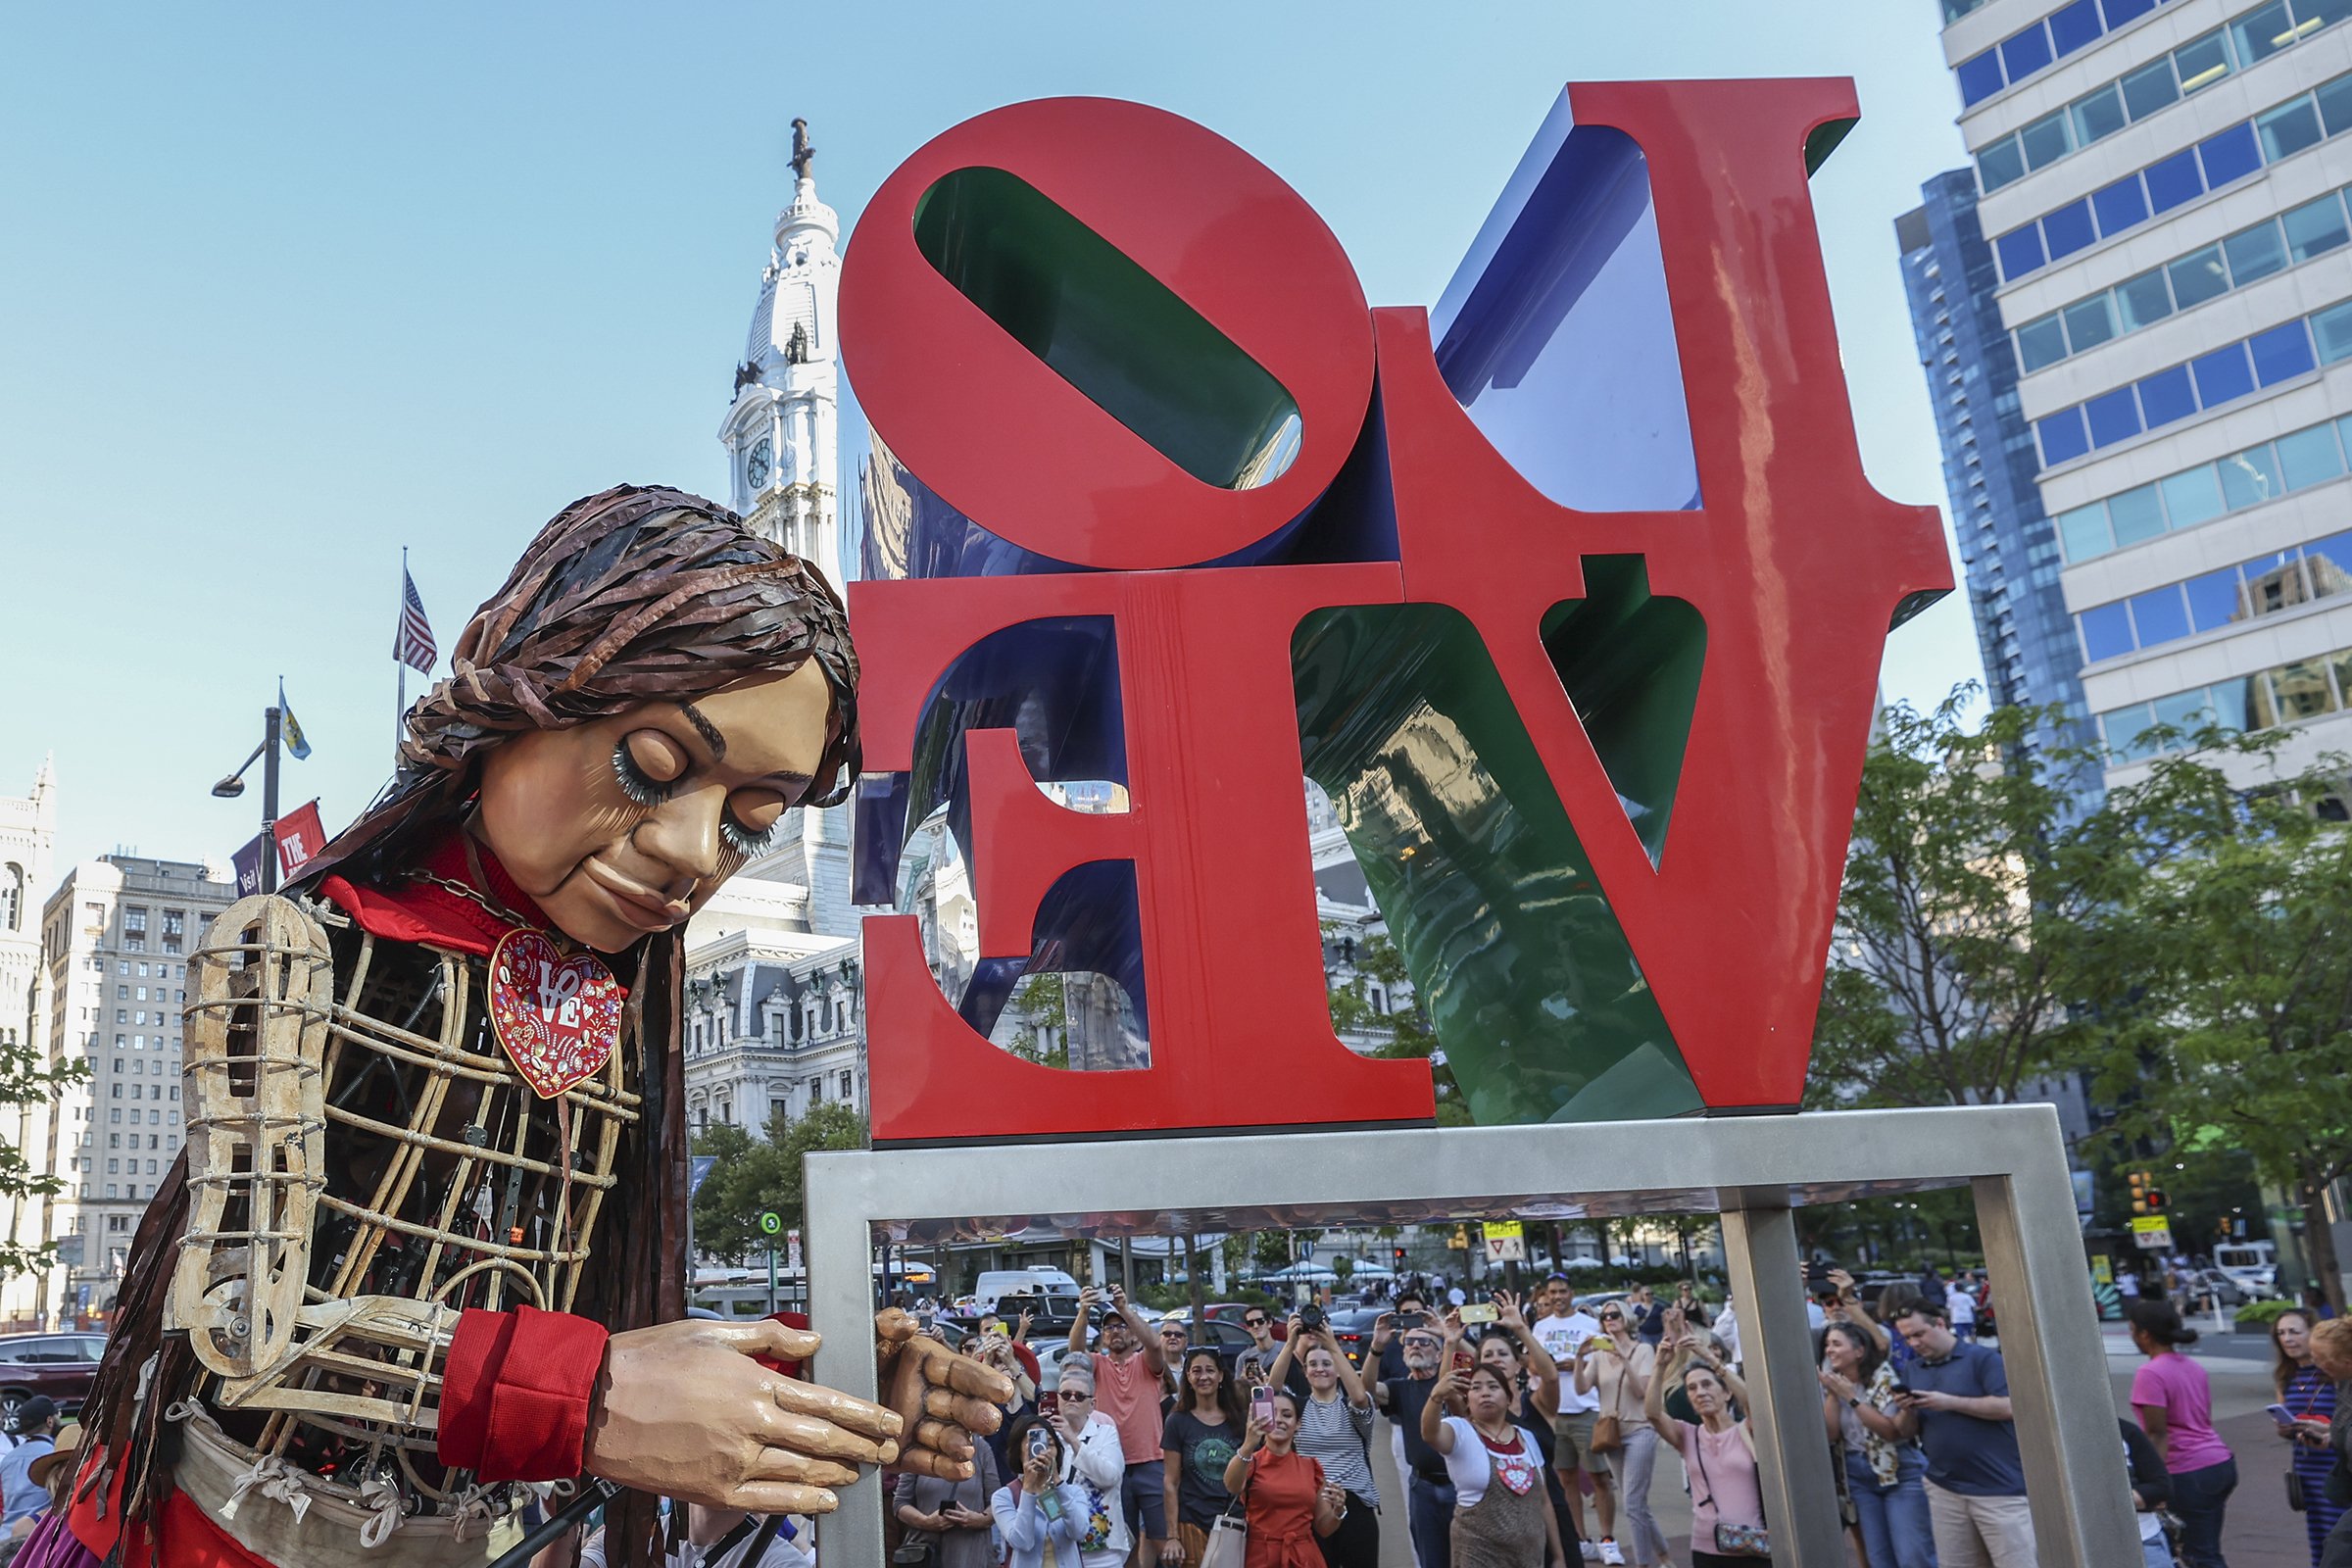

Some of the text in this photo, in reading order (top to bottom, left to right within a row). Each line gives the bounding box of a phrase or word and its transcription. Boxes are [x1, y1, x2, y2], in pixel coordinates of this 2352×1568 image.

[281, 832, 309, 866] THE
[240, 869, 258, 893] Visit
[538, 960, 580, 1003] LO
[538, 990, 581, 1028] VE
